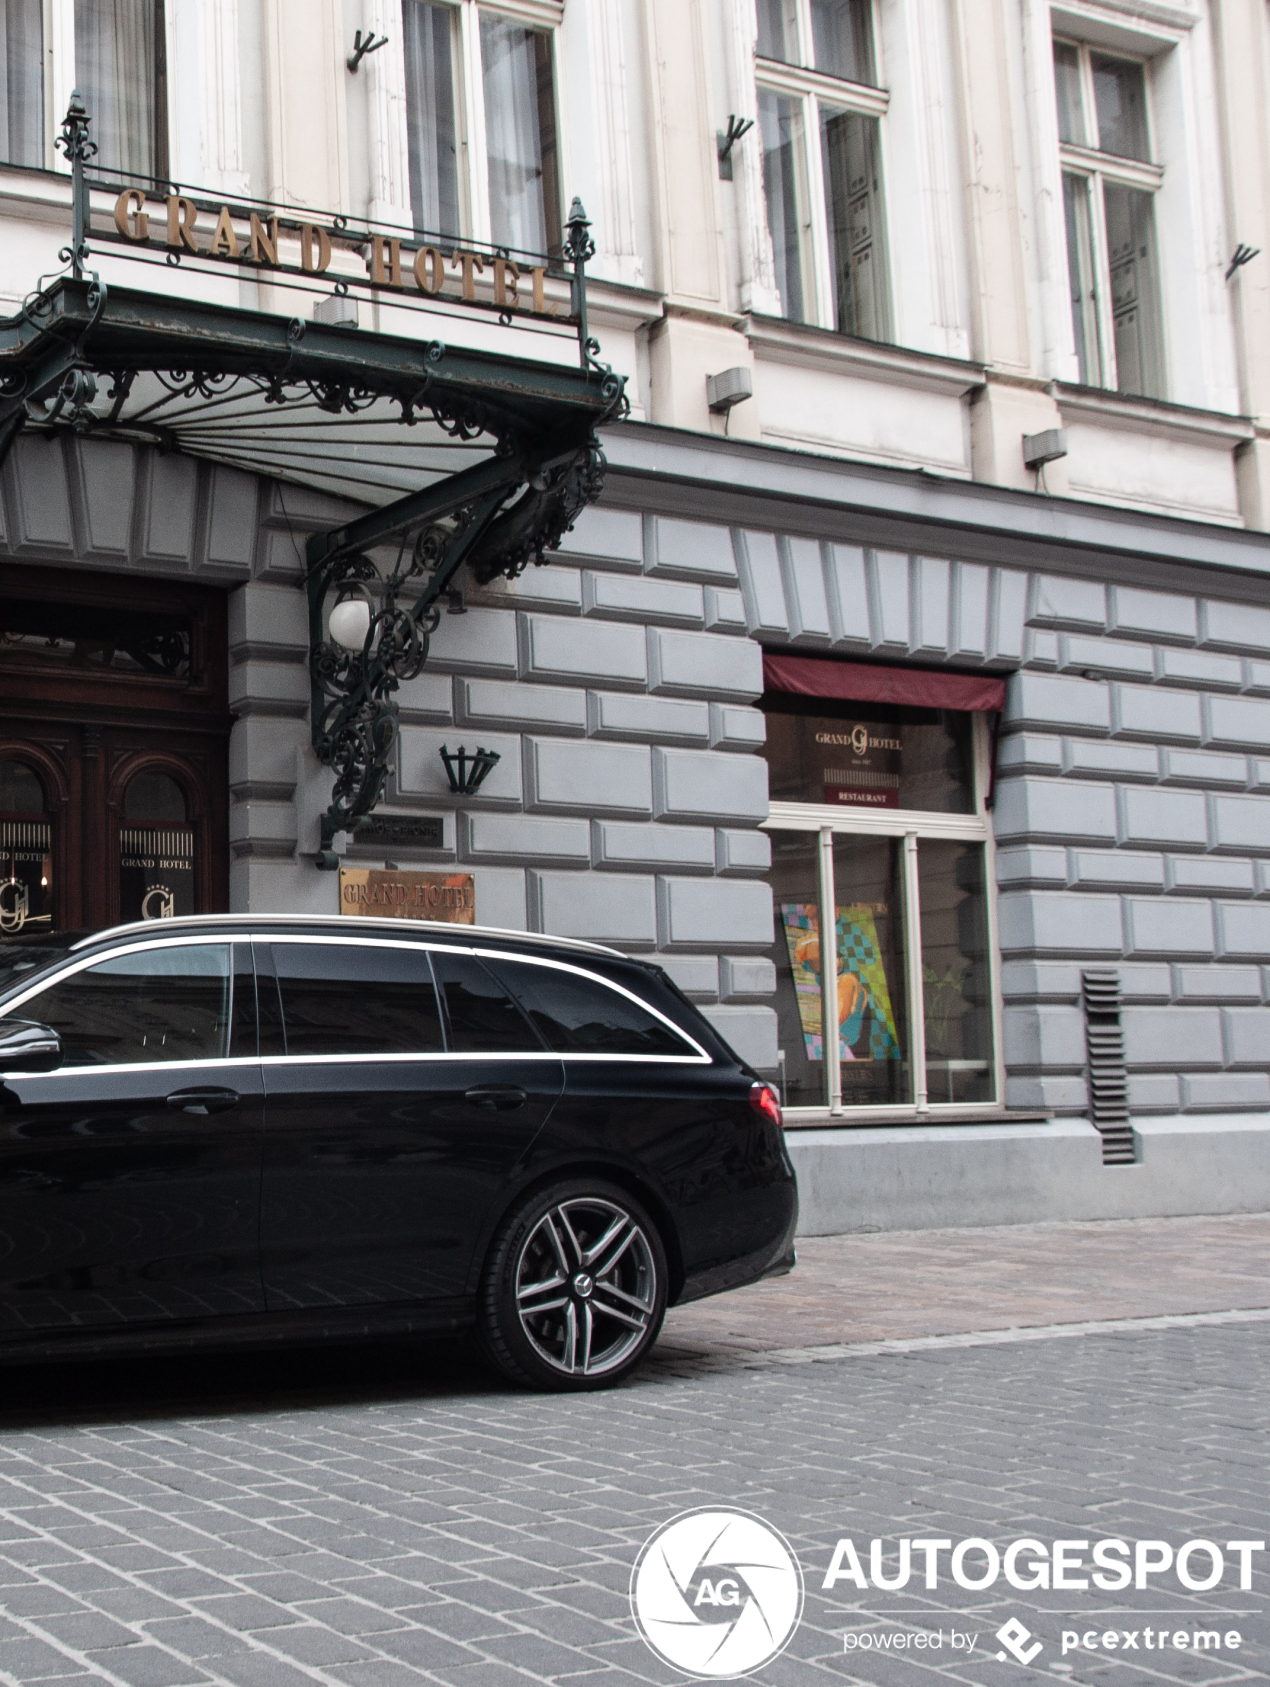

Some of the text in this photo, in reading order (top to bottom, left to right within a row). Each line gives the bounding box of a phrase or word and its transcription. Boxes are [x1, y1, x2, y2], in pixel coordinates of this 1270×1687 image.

[114, 188, 560, 316] GRAND HOTEL
[815, 733, 851, 745] GRAND
[869, 738, 902, 750] HOTEL
[838, 792, 886, 803] RESTAURANT
[14, 852, 49, 862] HOTEL
[121, 858, 193, 870] GRAND HOTEL
[343, 883, 474, 908] GRAND HOTEL
